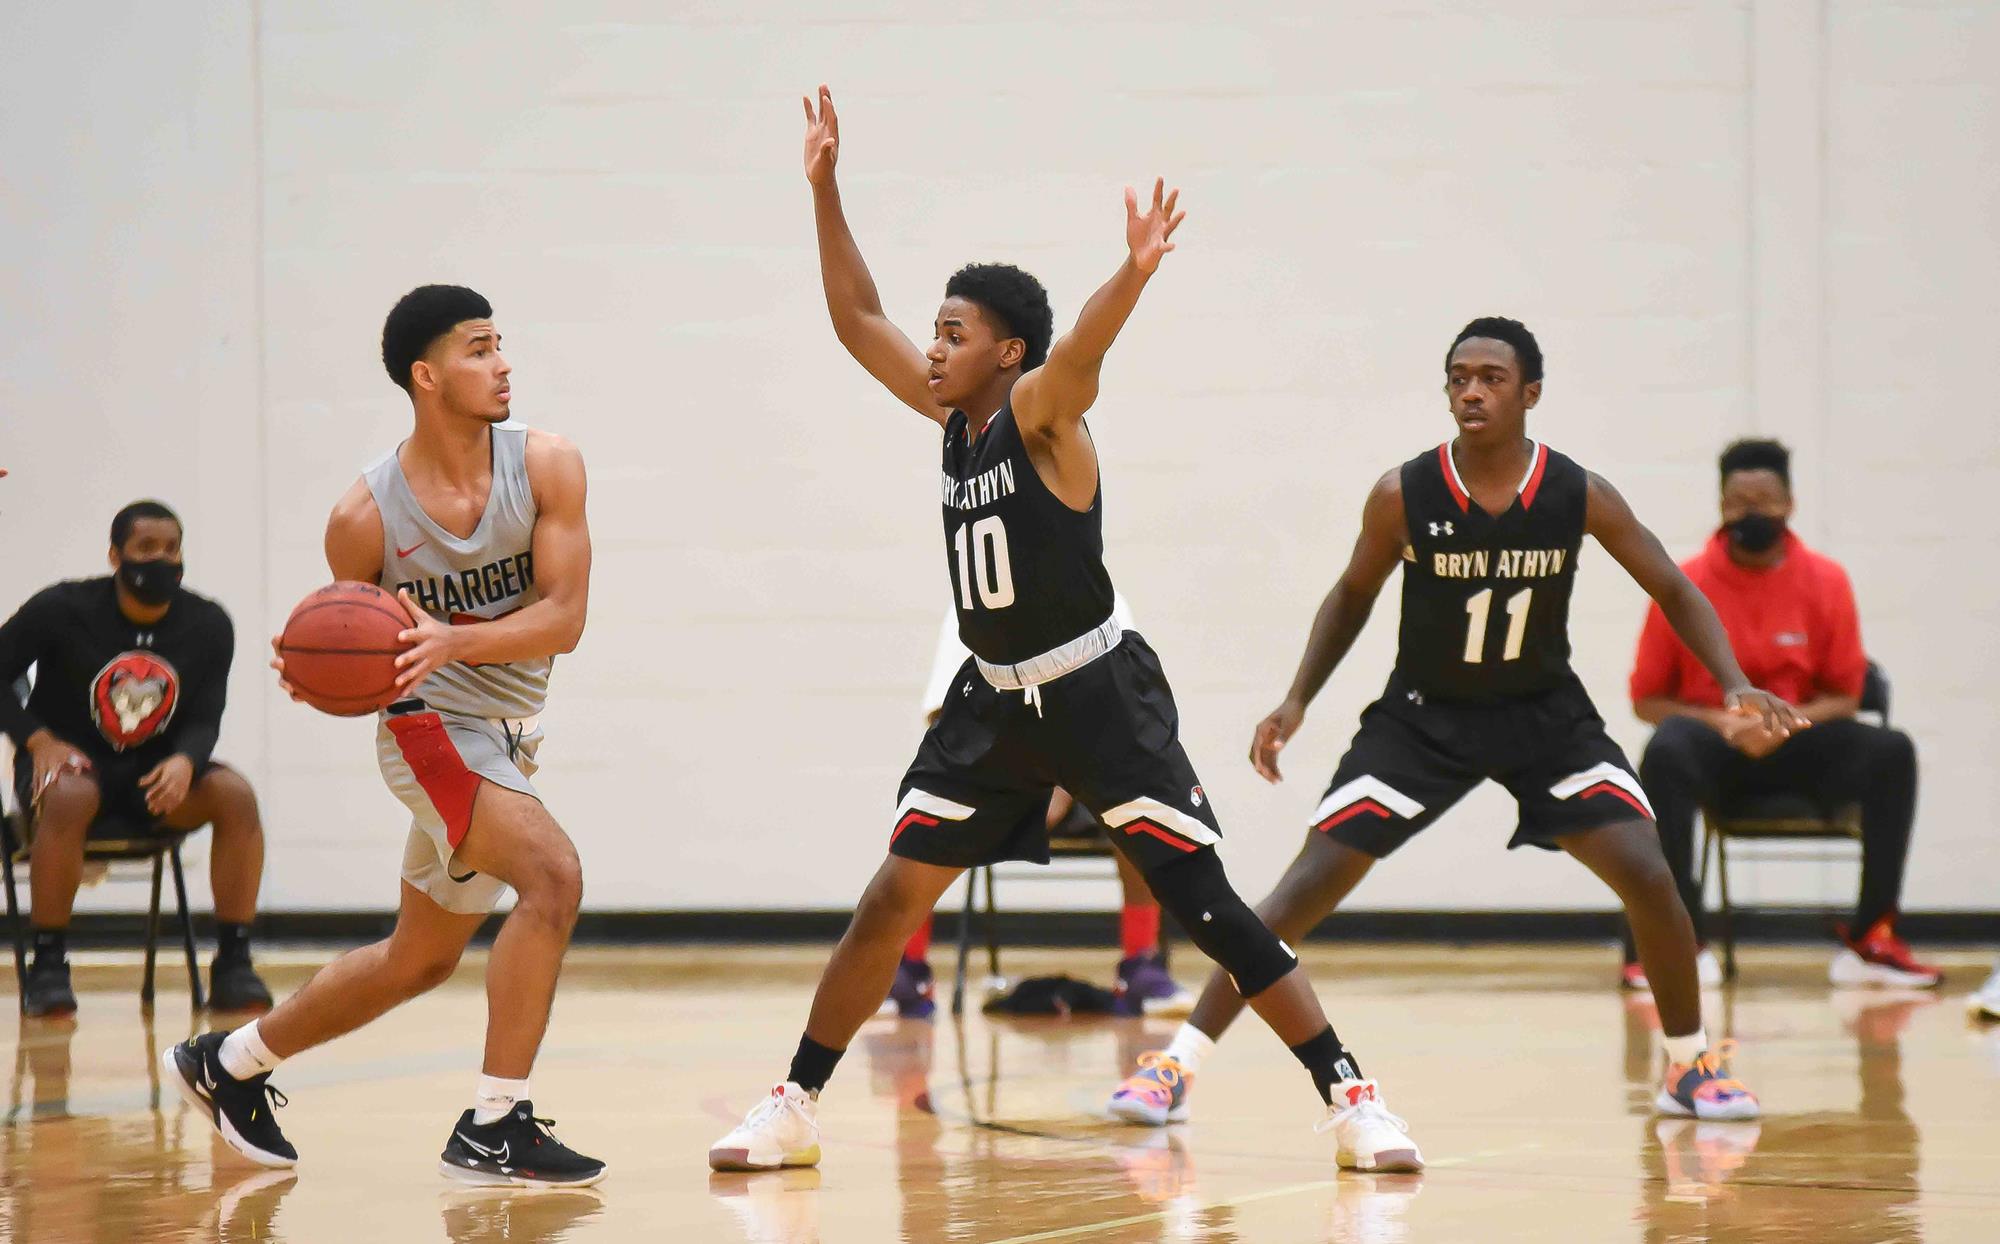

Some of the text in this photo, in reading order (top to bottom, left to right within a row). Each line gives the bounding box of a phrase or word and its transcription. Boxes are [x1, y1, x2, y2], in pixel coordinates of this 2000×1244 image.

[960, 458, 1015, 510] ATHYN
[955, 515, 1015, 609] 10
[1434, 549, 1567, 578] BRYN ATHYN
[1463, 587, 1533, 663] 11
